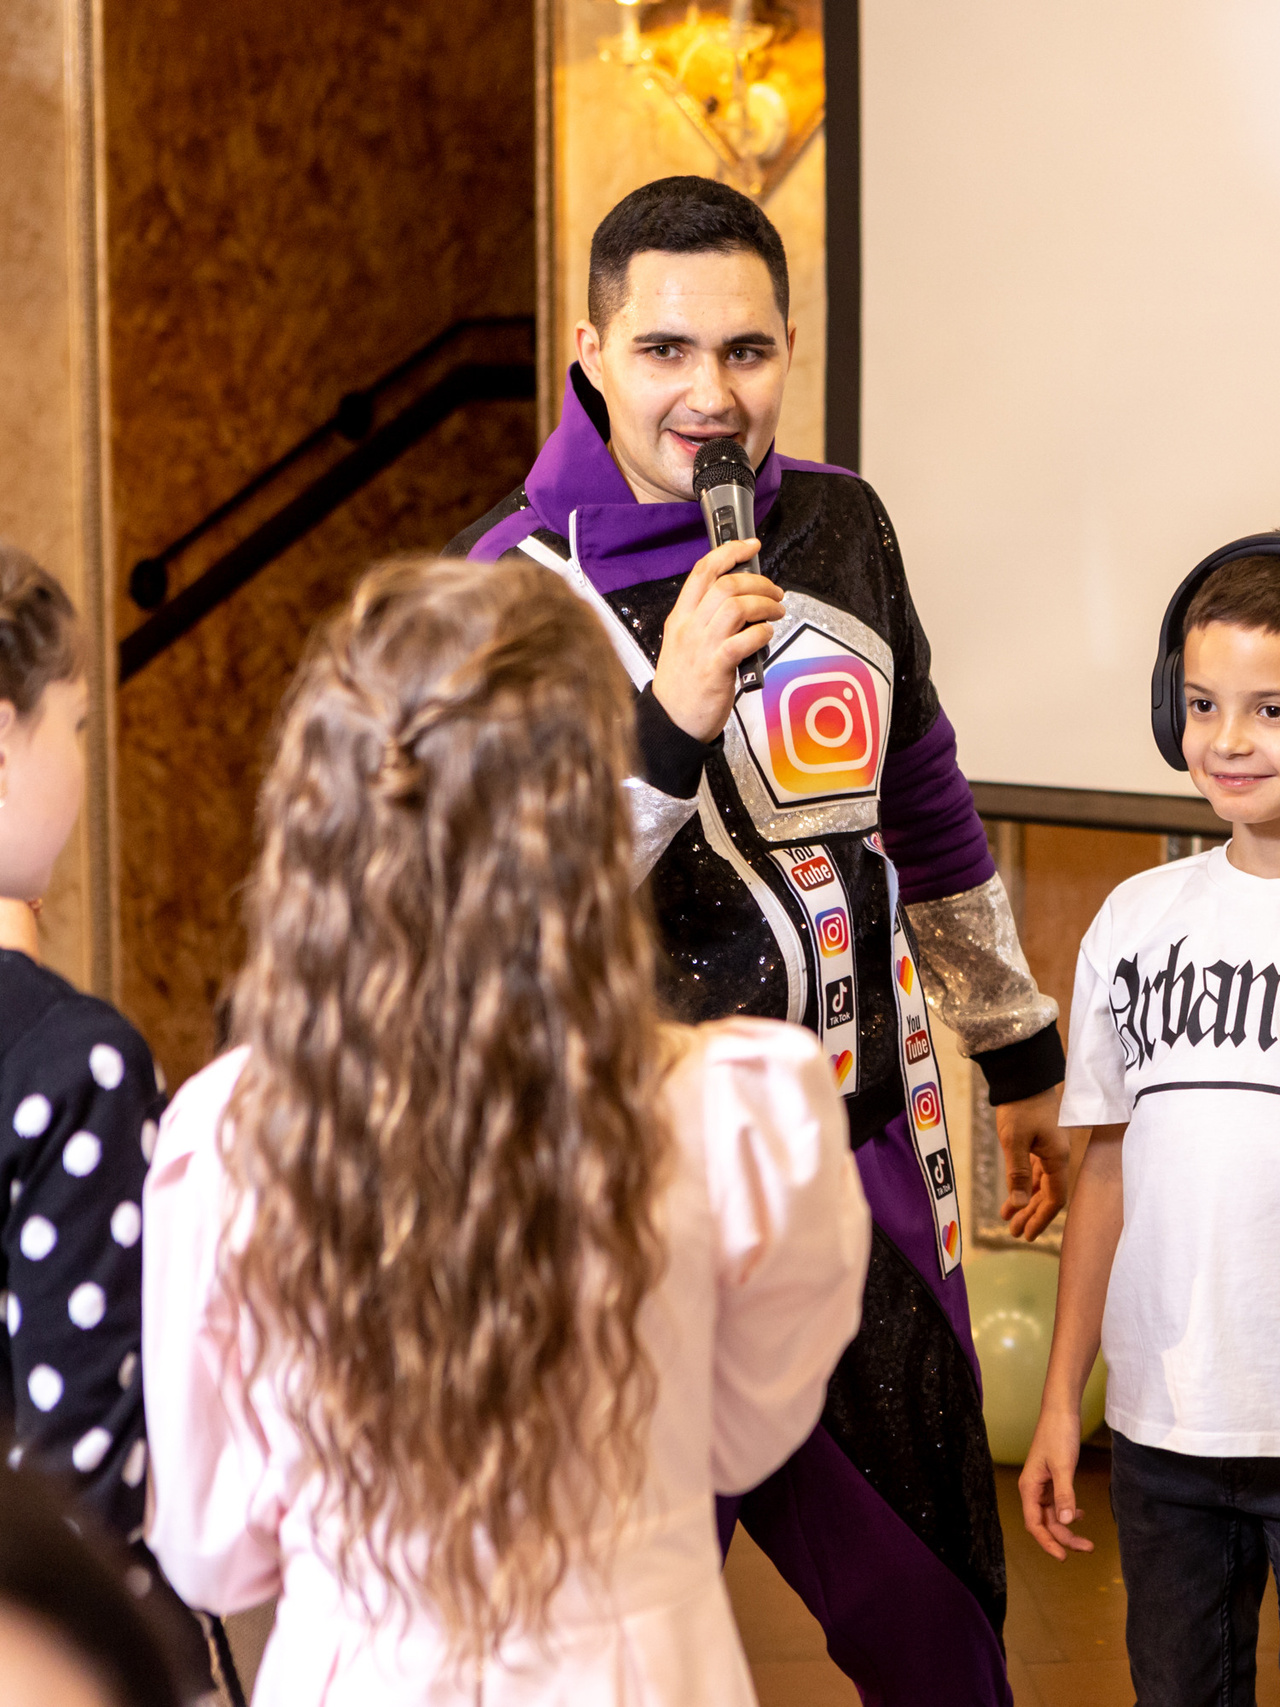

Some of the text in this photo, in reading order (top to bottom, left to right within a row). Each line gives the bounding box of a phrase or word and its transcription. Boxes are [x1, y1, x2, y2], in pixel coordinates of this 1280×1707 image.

[783, 845, 815, 864] You
[794, 864, 832, 887] Tube
[830, 1011, 851, 1026] TikTok
[906, 1014, 921, 1035] You
[906, 1036, 929, 1060] Tube
